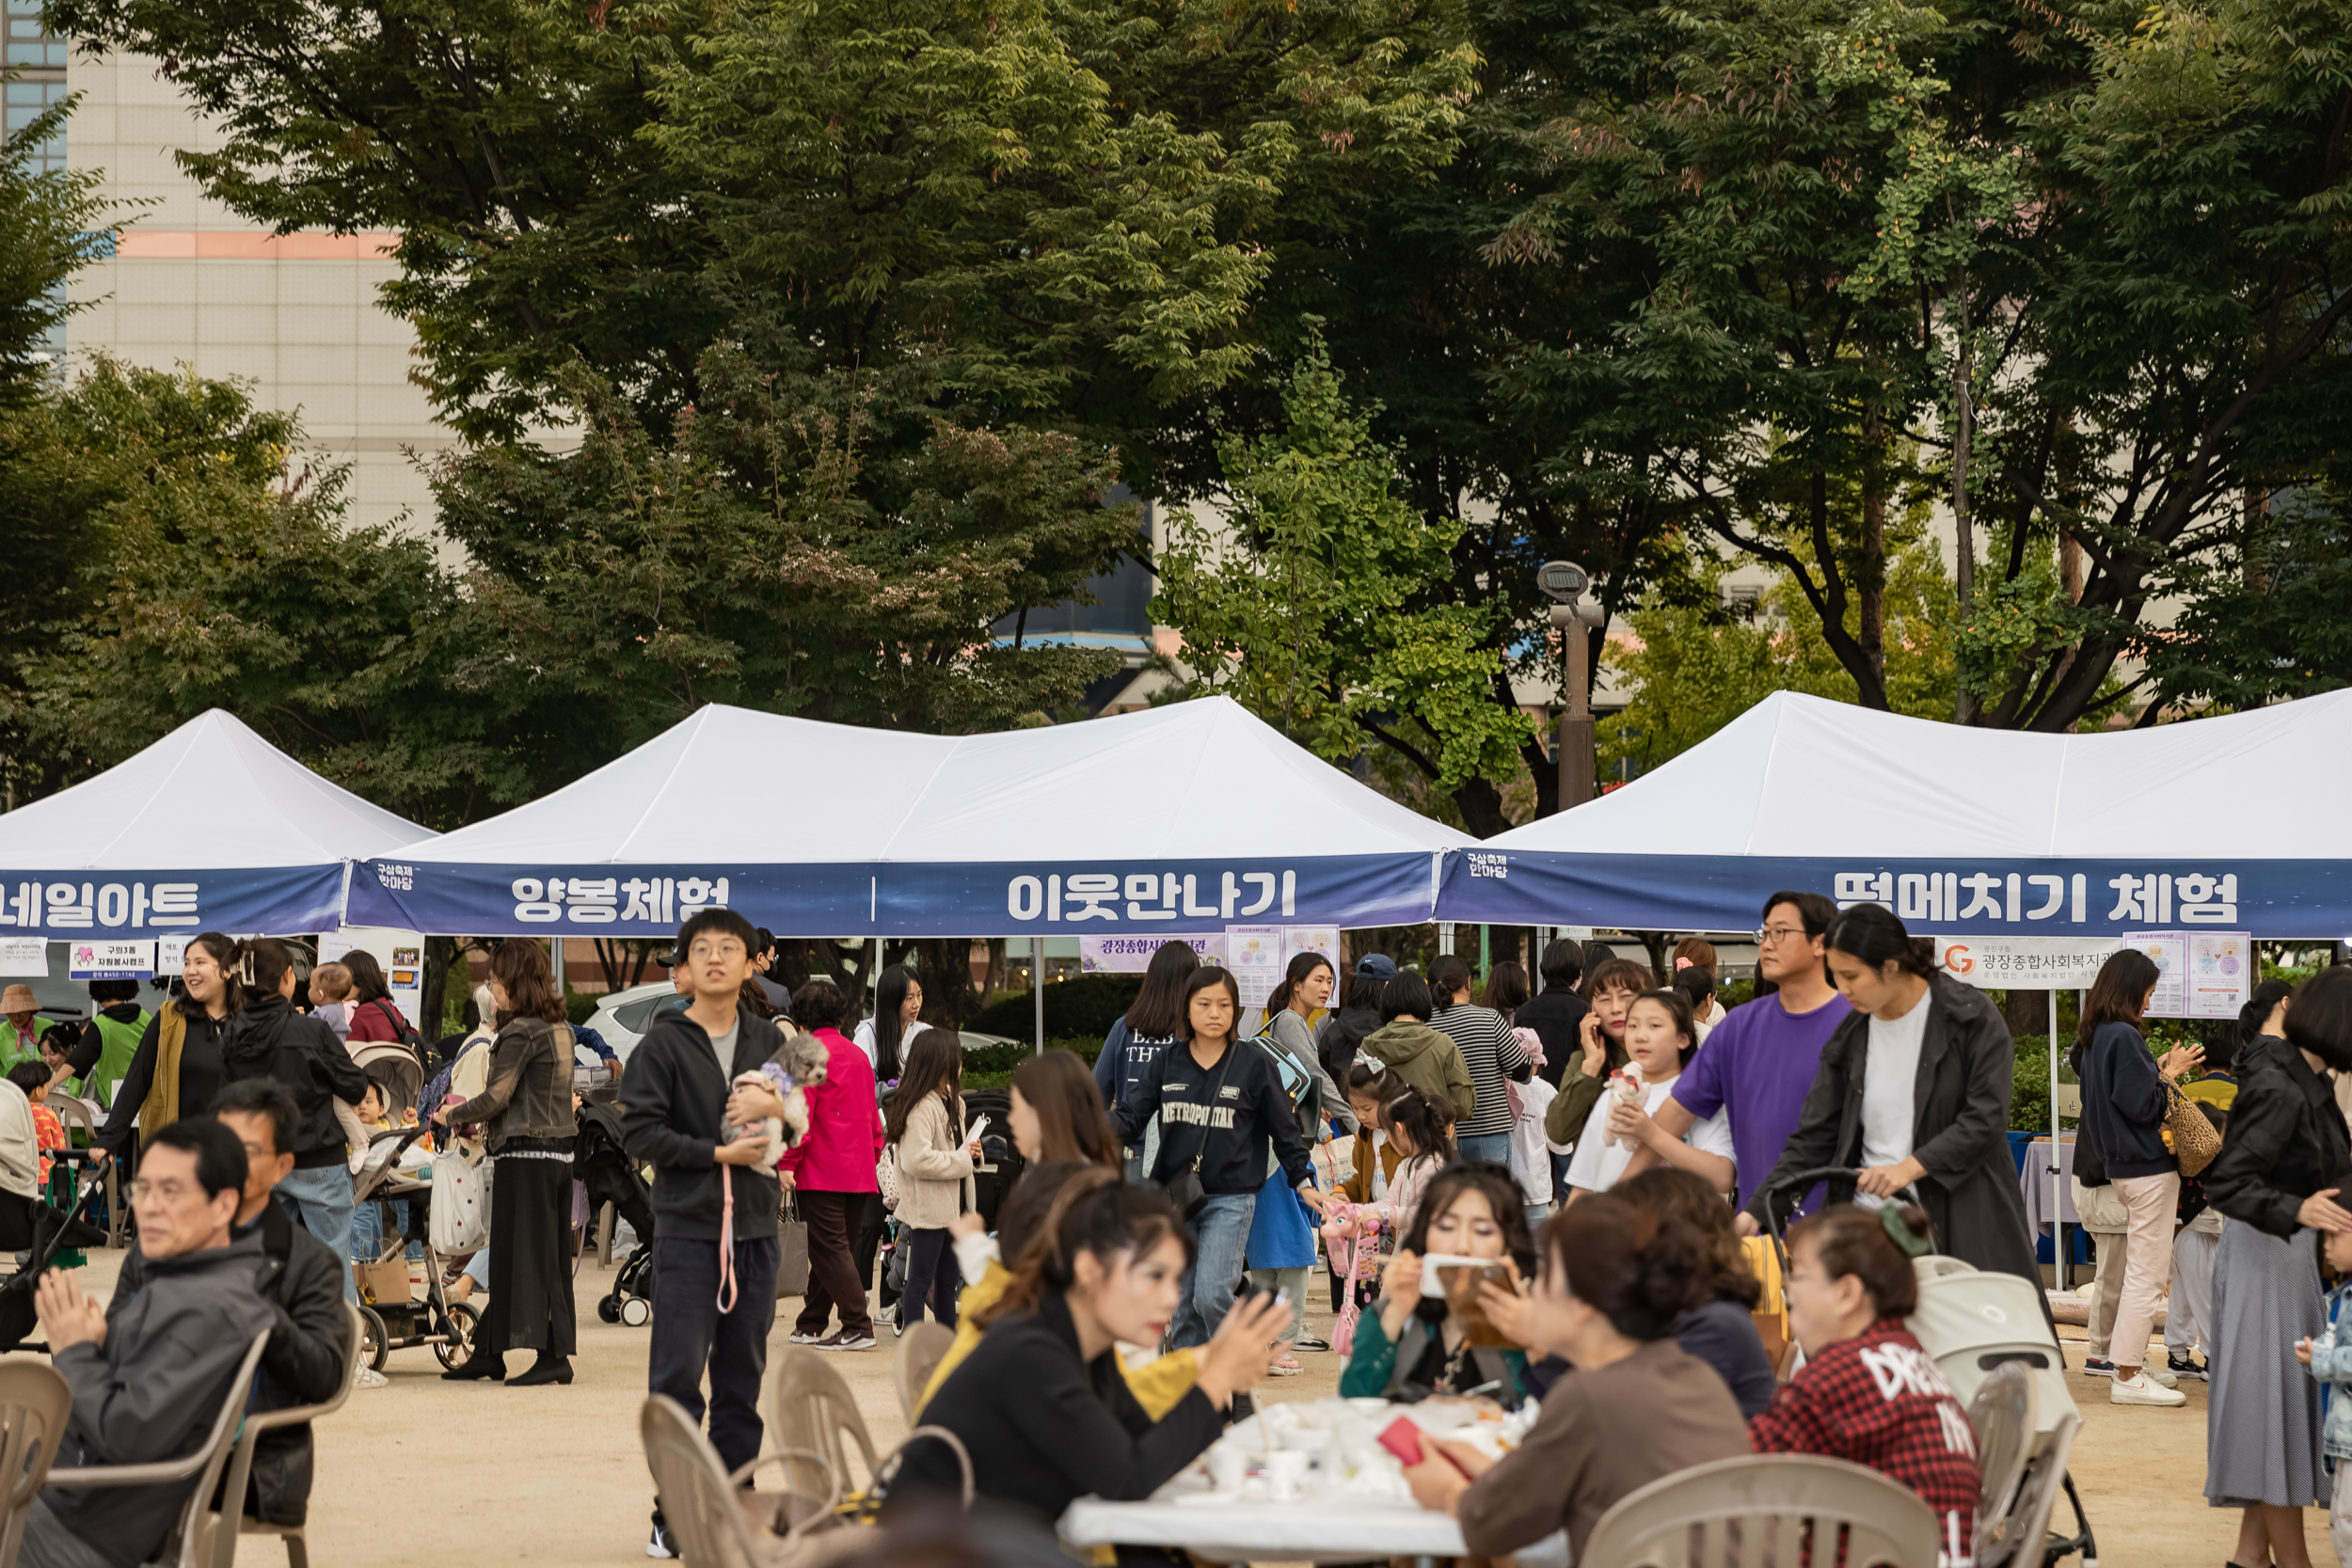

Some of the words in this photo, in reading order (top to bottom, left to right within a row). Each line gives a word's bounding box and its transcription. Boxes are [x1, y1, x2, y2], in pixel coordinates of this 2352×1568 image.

[1469, 863, 1508, 879] 한마당
[0, 881, 200, 927] 네일아트
[512, 876, 729, 924] 양봉체험
[1008, 869, 1296, 922] 이웃만나기
[2107, 872, 2238, 925] 체험
[1983, 971, 2017, 979] 운영법인
[2023, 971, 2074, 979] 사회복지법인
